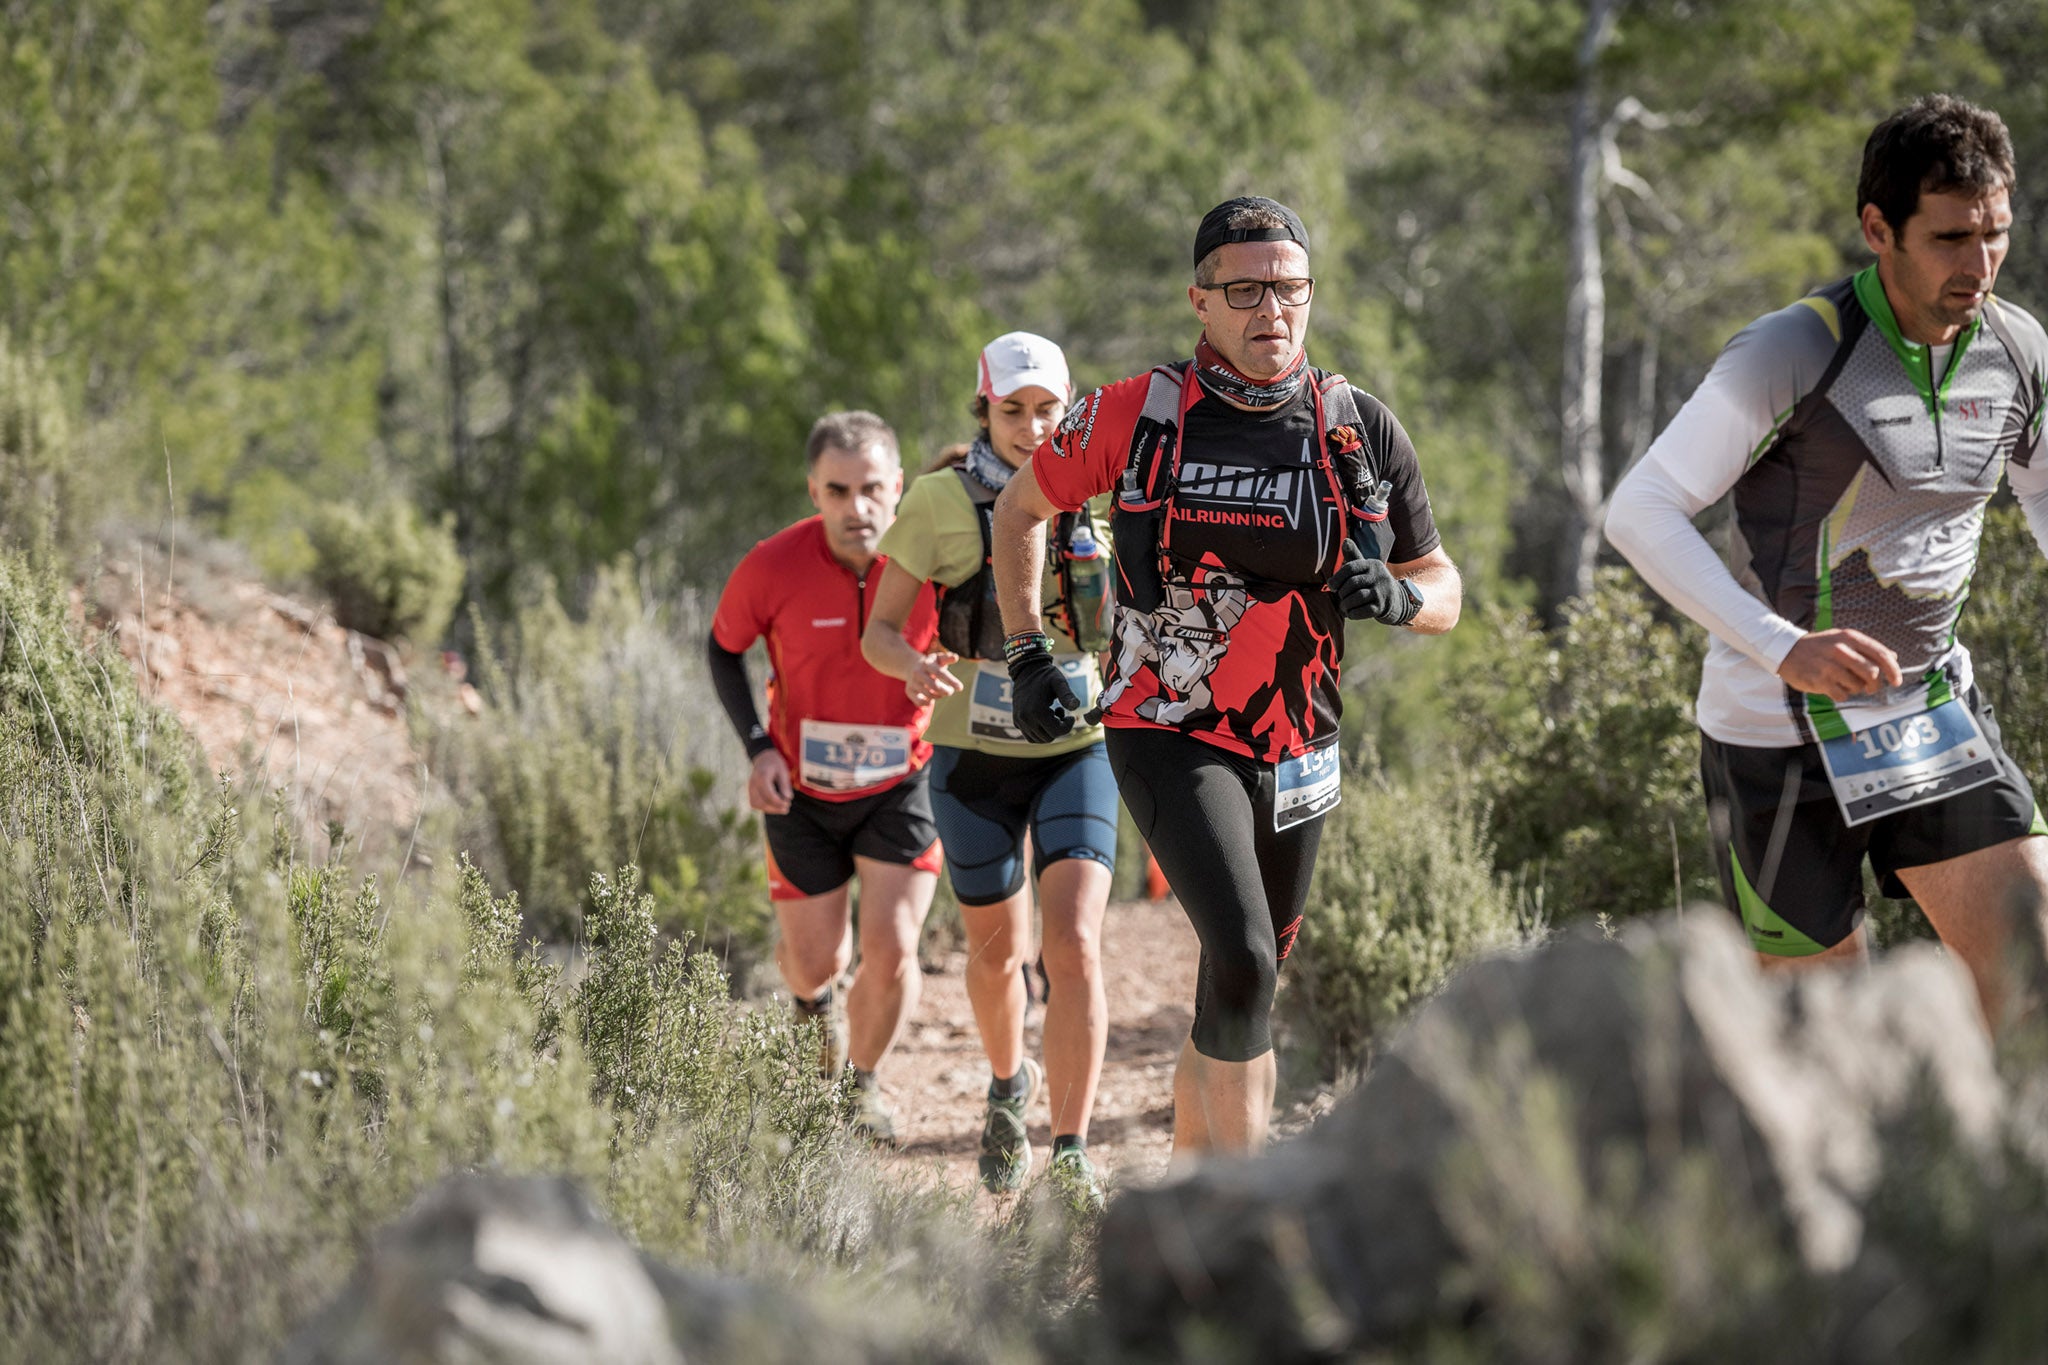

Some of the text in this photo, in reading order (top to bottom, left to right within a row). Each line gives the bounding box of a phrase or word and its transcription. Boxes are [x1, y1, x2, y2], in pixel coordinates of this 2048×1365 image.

[1171, 507, 1285, 528] AILRUNNING
[1857, 715, 1941, 759] 1063
[825, 744, 887, 768] 1370
[1299, 741, 1339, 778] 134
